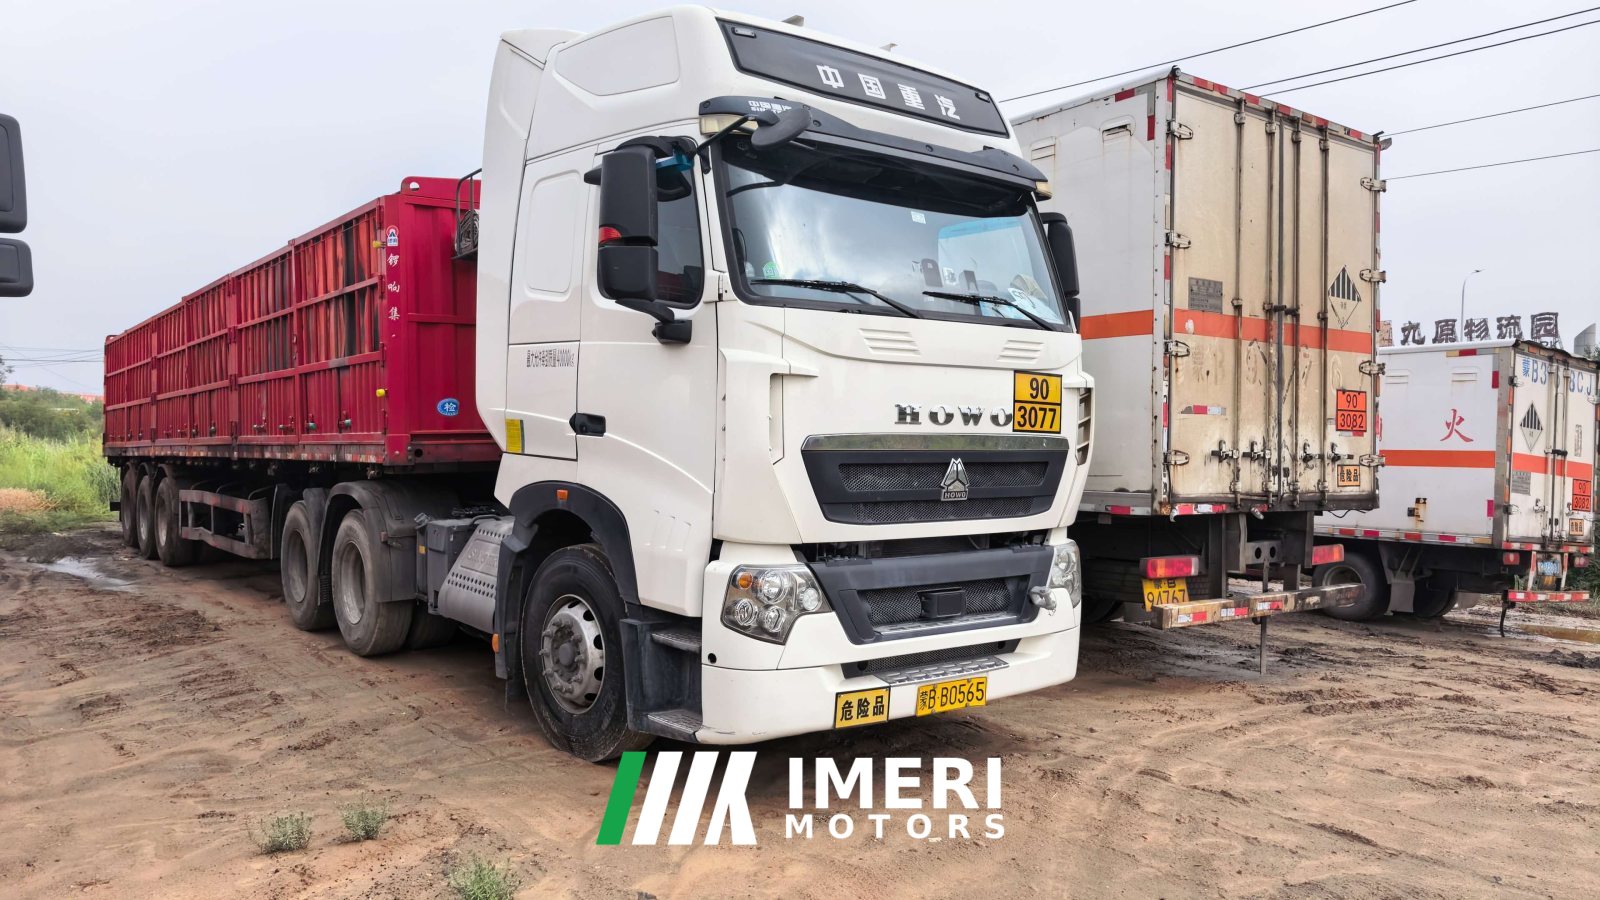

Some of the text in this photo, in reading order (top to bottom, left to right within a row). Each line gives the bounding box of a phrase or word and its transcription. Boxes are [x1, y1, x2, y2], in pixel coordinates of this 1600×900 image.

[1400, 312, 1559, 346] 九原物流园
[1029, 377, 1049, 400] 90
[1345, 393, 1358, 409] 90
[894, 403, 1013, 427] HOWO
[1017, 405, 1057, 429] 3077
[1340, 413, 1364, 429] 3082
[1440, 408, 1474, 443] 火
[840, 695, 885, 721] 危险品
